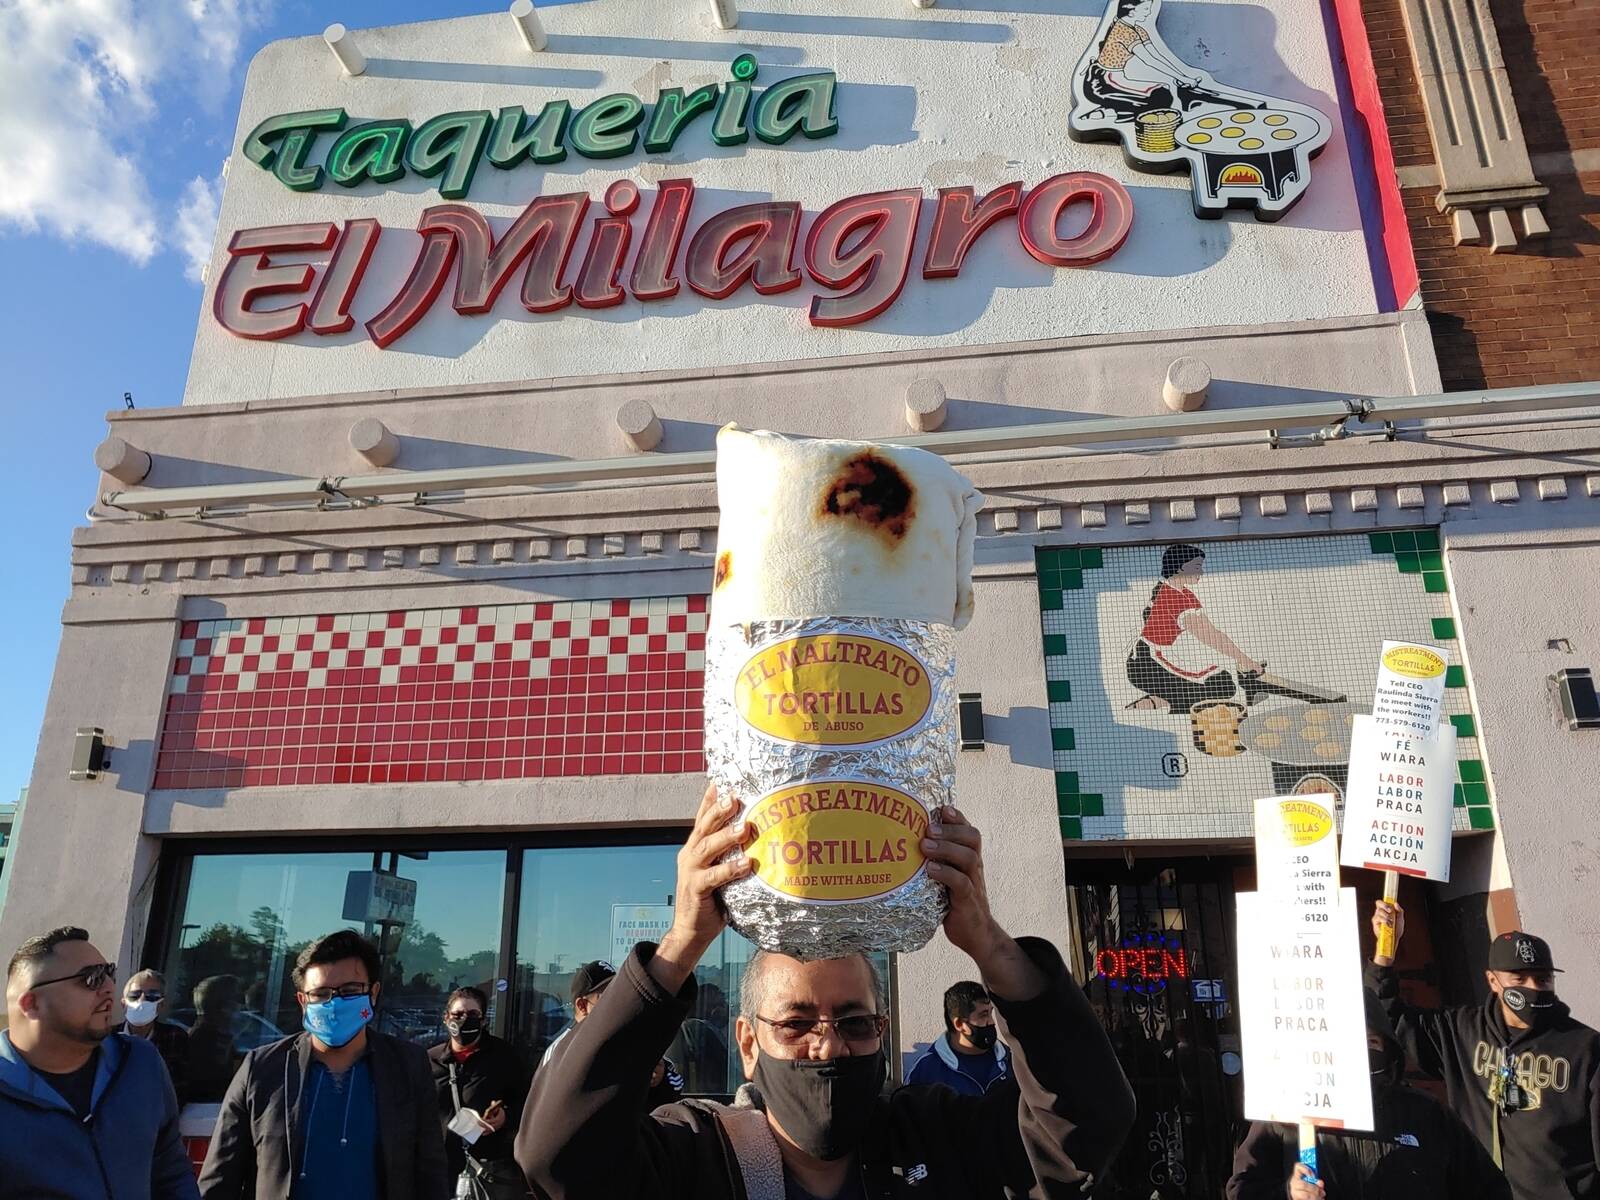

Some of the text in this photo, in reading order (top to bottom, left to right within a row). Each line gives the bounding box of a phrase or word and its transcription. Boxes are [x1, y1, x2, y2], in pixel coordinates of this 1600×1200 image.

[243, 53, 839, 199] Taqueria
[212, 171, 1135, 349] El Milagro
[744, 641, 921, 690] EL MALTRATO
[1392, 659, 1435, 672] TORTILLAS
[1390, 680, 1423, 690] Tell CEO
[764, 691, 904, 716] TORTILLAS
[1391, 699, 1412, 707] meet
[1414, 703, 1432, 712] with
[1414, 693, 1439, 704] Sierra
[803, 720, 864, 732] DE ABUSO
[1375, 717, 1431, 730] 773-579-6120
[1380, 752, 1426, 766] WIARA
[1379, 773, 1424, 788] LABOR
[1378, 786, 1423, 801] LABOR
[1376, 799, 1423, 814] PRACA
[1372, 820, 1424, 836] ACTION
[1370, 833, 1424, 850] ACCIÓN
[768, 838, 907, 865] TORTILLAS
[1373, 847, 1418, 863] AKCJA
[784, 873, 892, 886] MADE WITH ABUSE
[1302, 869, 1332, 878] Sierra
[639, 920, 660, 928] MASK
[1097, 948, 1186, 978] OPEN
[1275, 1016, 1328, 1031] PRACA
